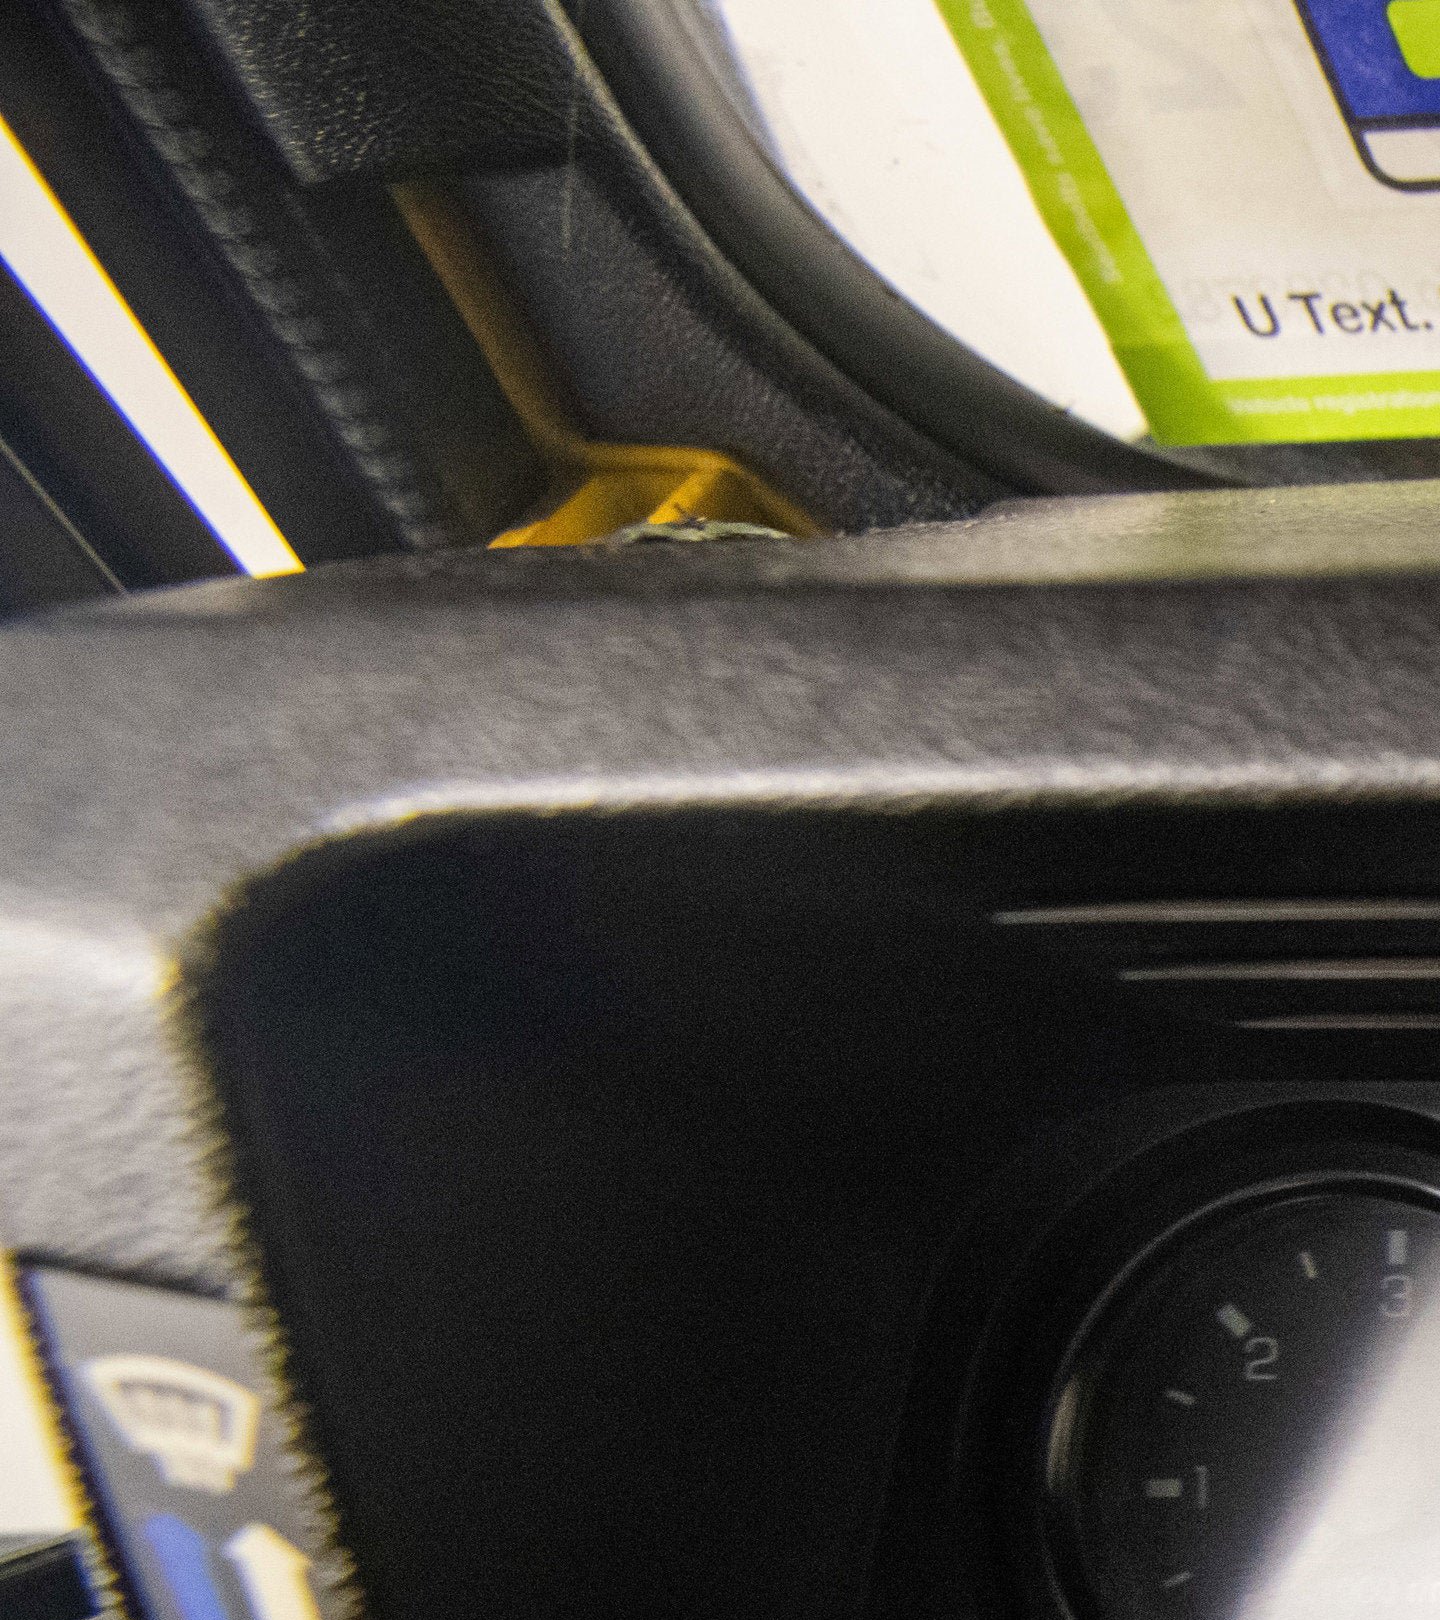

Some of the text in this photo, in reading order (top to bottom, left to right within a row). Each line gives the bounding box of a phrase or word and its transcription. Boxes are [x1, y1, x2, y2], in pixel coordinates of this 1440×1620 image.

[1232, 294, 1280, 337] U
[1290, 290, 1433, 332] Text.
[1378, 1275, 1411, 1319] 3
[1245, 1337, 1279, 1381] 2
